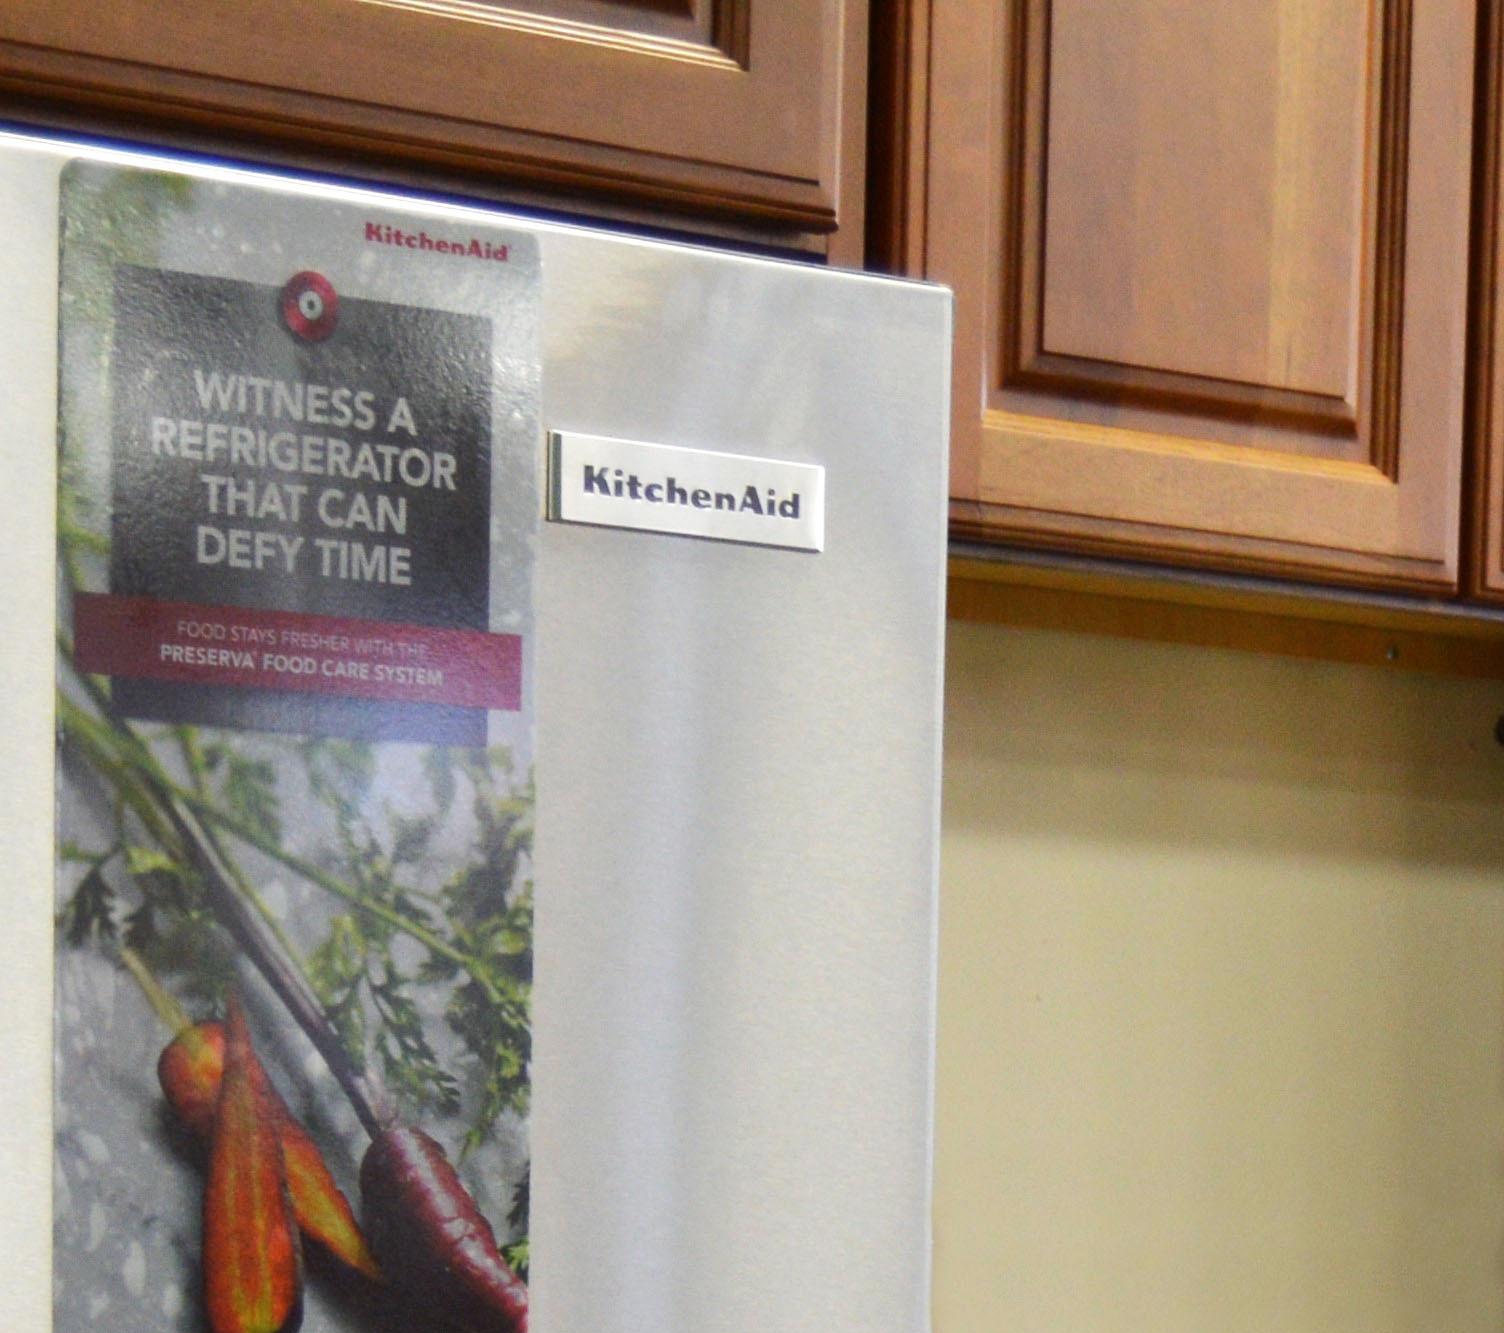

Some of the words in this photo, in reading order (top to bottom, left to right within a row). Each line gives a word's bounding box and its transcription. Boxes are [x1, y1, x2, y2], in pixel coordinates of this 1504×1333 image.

[364, 222, 509, 263] KitchenAid
[193, 368, 377, 431] WITNESS
[387, 397, 418, 437] A
[151, 415, 458, 491] REFRIGERATOR
[201, 473, 308, 523] THAT
[318, 488, 408, 535] CAN
[583, 464, 802, 520] KitchenAid
[197, 525, 305, 574] DEFY
[315, 537, 412, 587] TIME
[177, 620, 226, 641] FOOD
[231, 624, 277, 645] STAYS
[281, 630, 349, 652] FRESHER
[355, 638, 396, 656] WITH
[398, 643, 430, 658] THE
[263, 653, 317, 675] FOOD
[322, 659, 369, 681] CARE
[374, 664, 444, 686] SYSTEM
